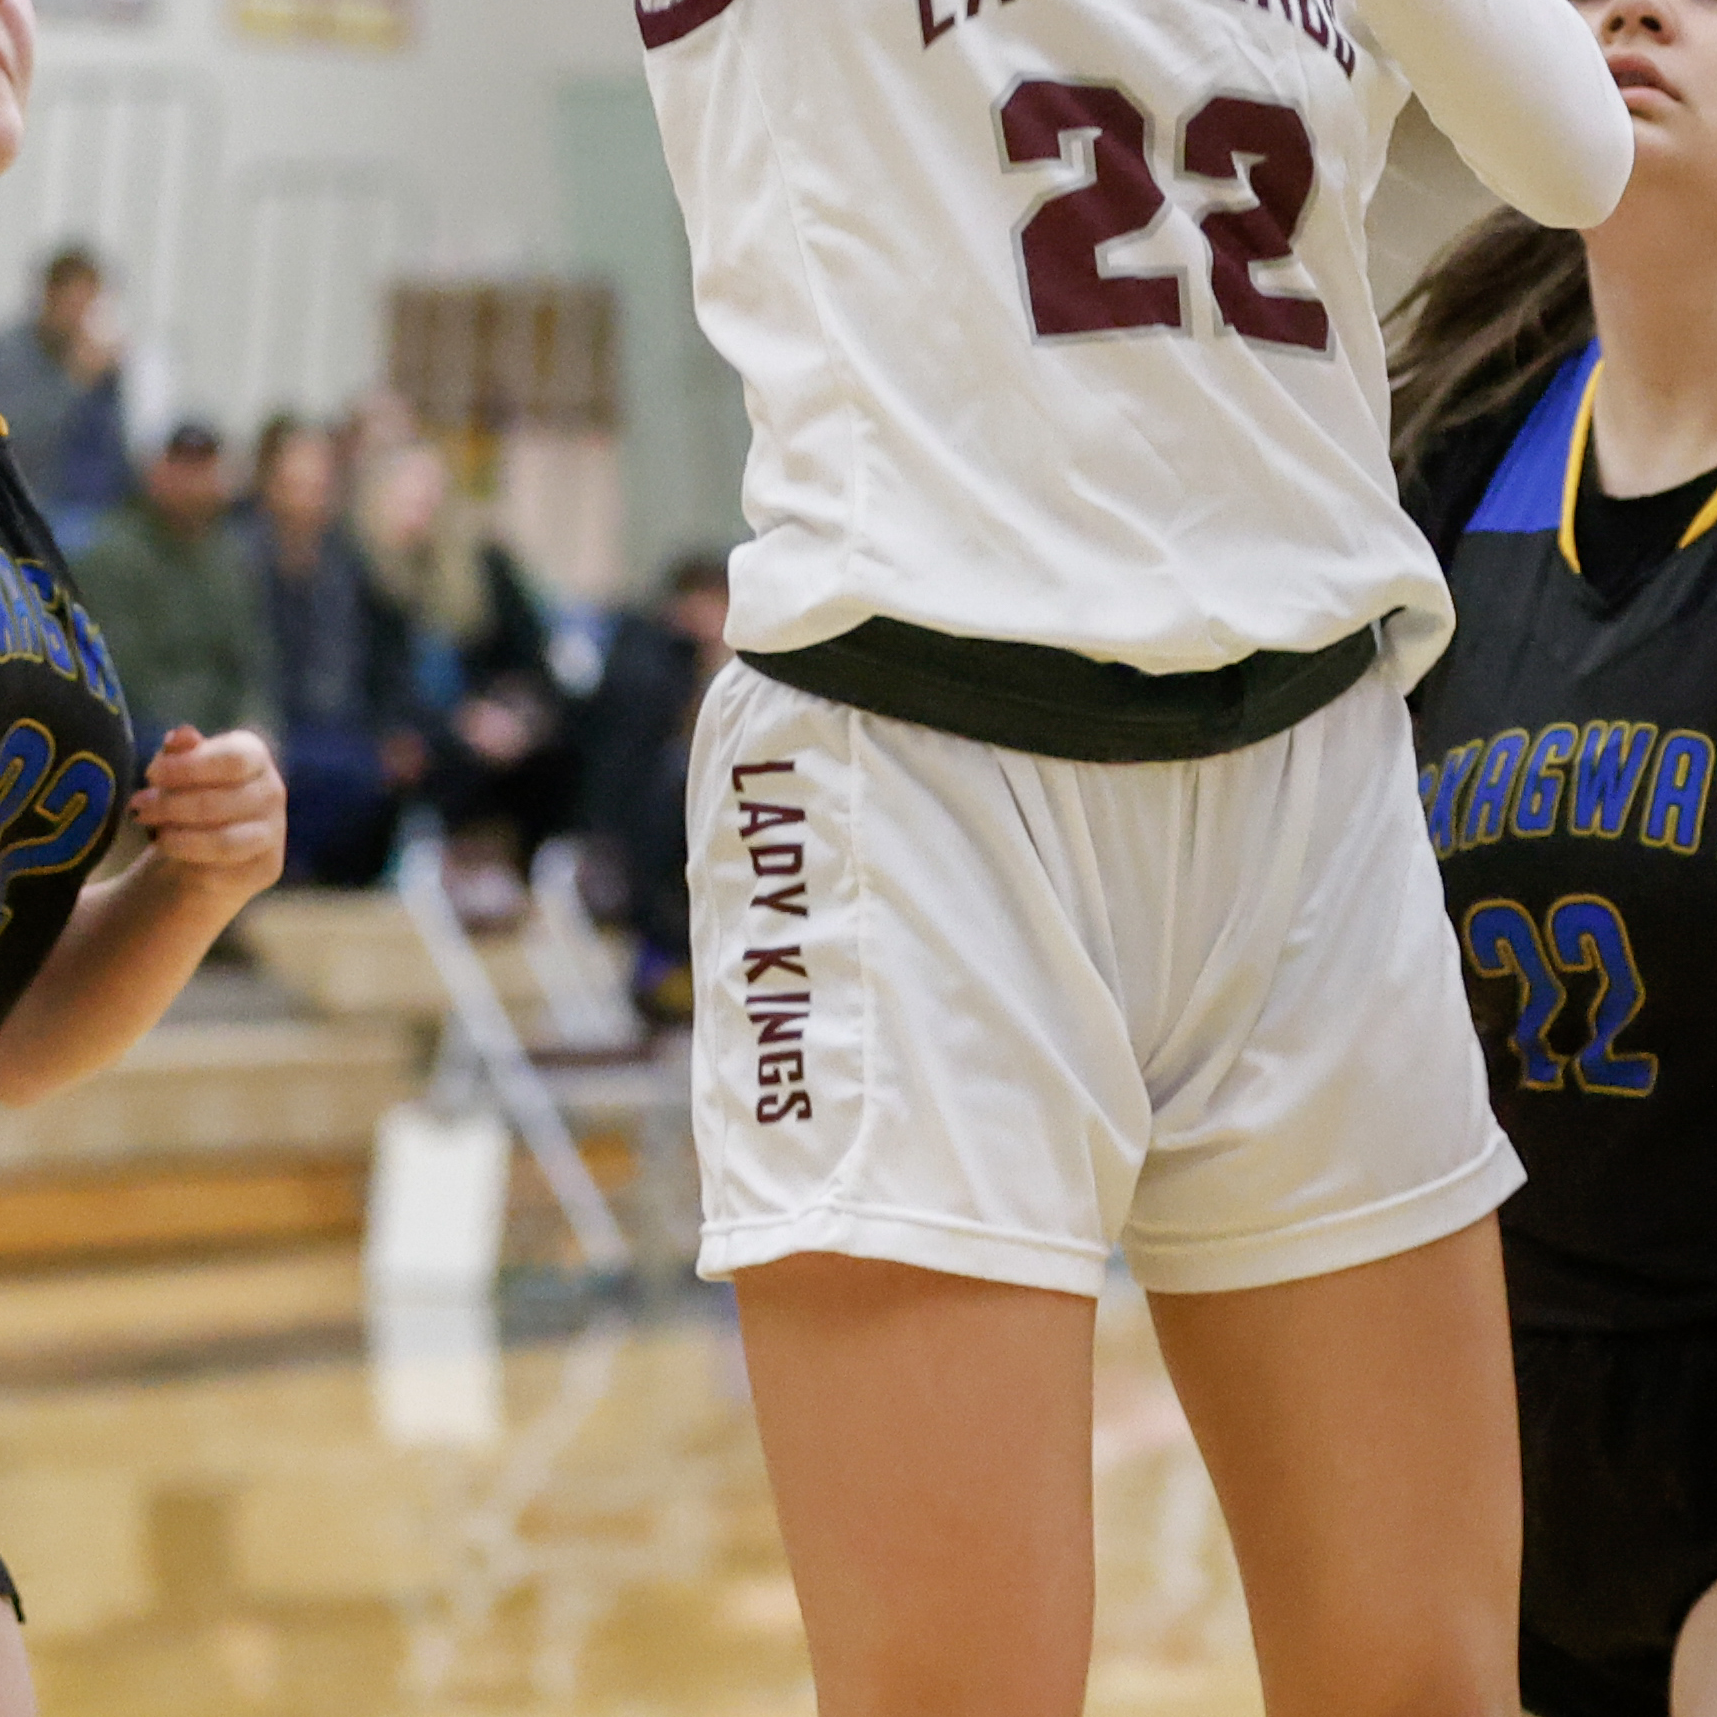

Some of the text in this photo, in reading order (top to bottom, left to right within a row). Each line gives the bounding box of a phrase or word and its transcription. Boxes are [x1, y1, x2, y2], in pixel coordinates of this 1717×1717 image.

[990, 71, 1337, 362] 22
[731, 760, 814, 1127] LADY KINGS
